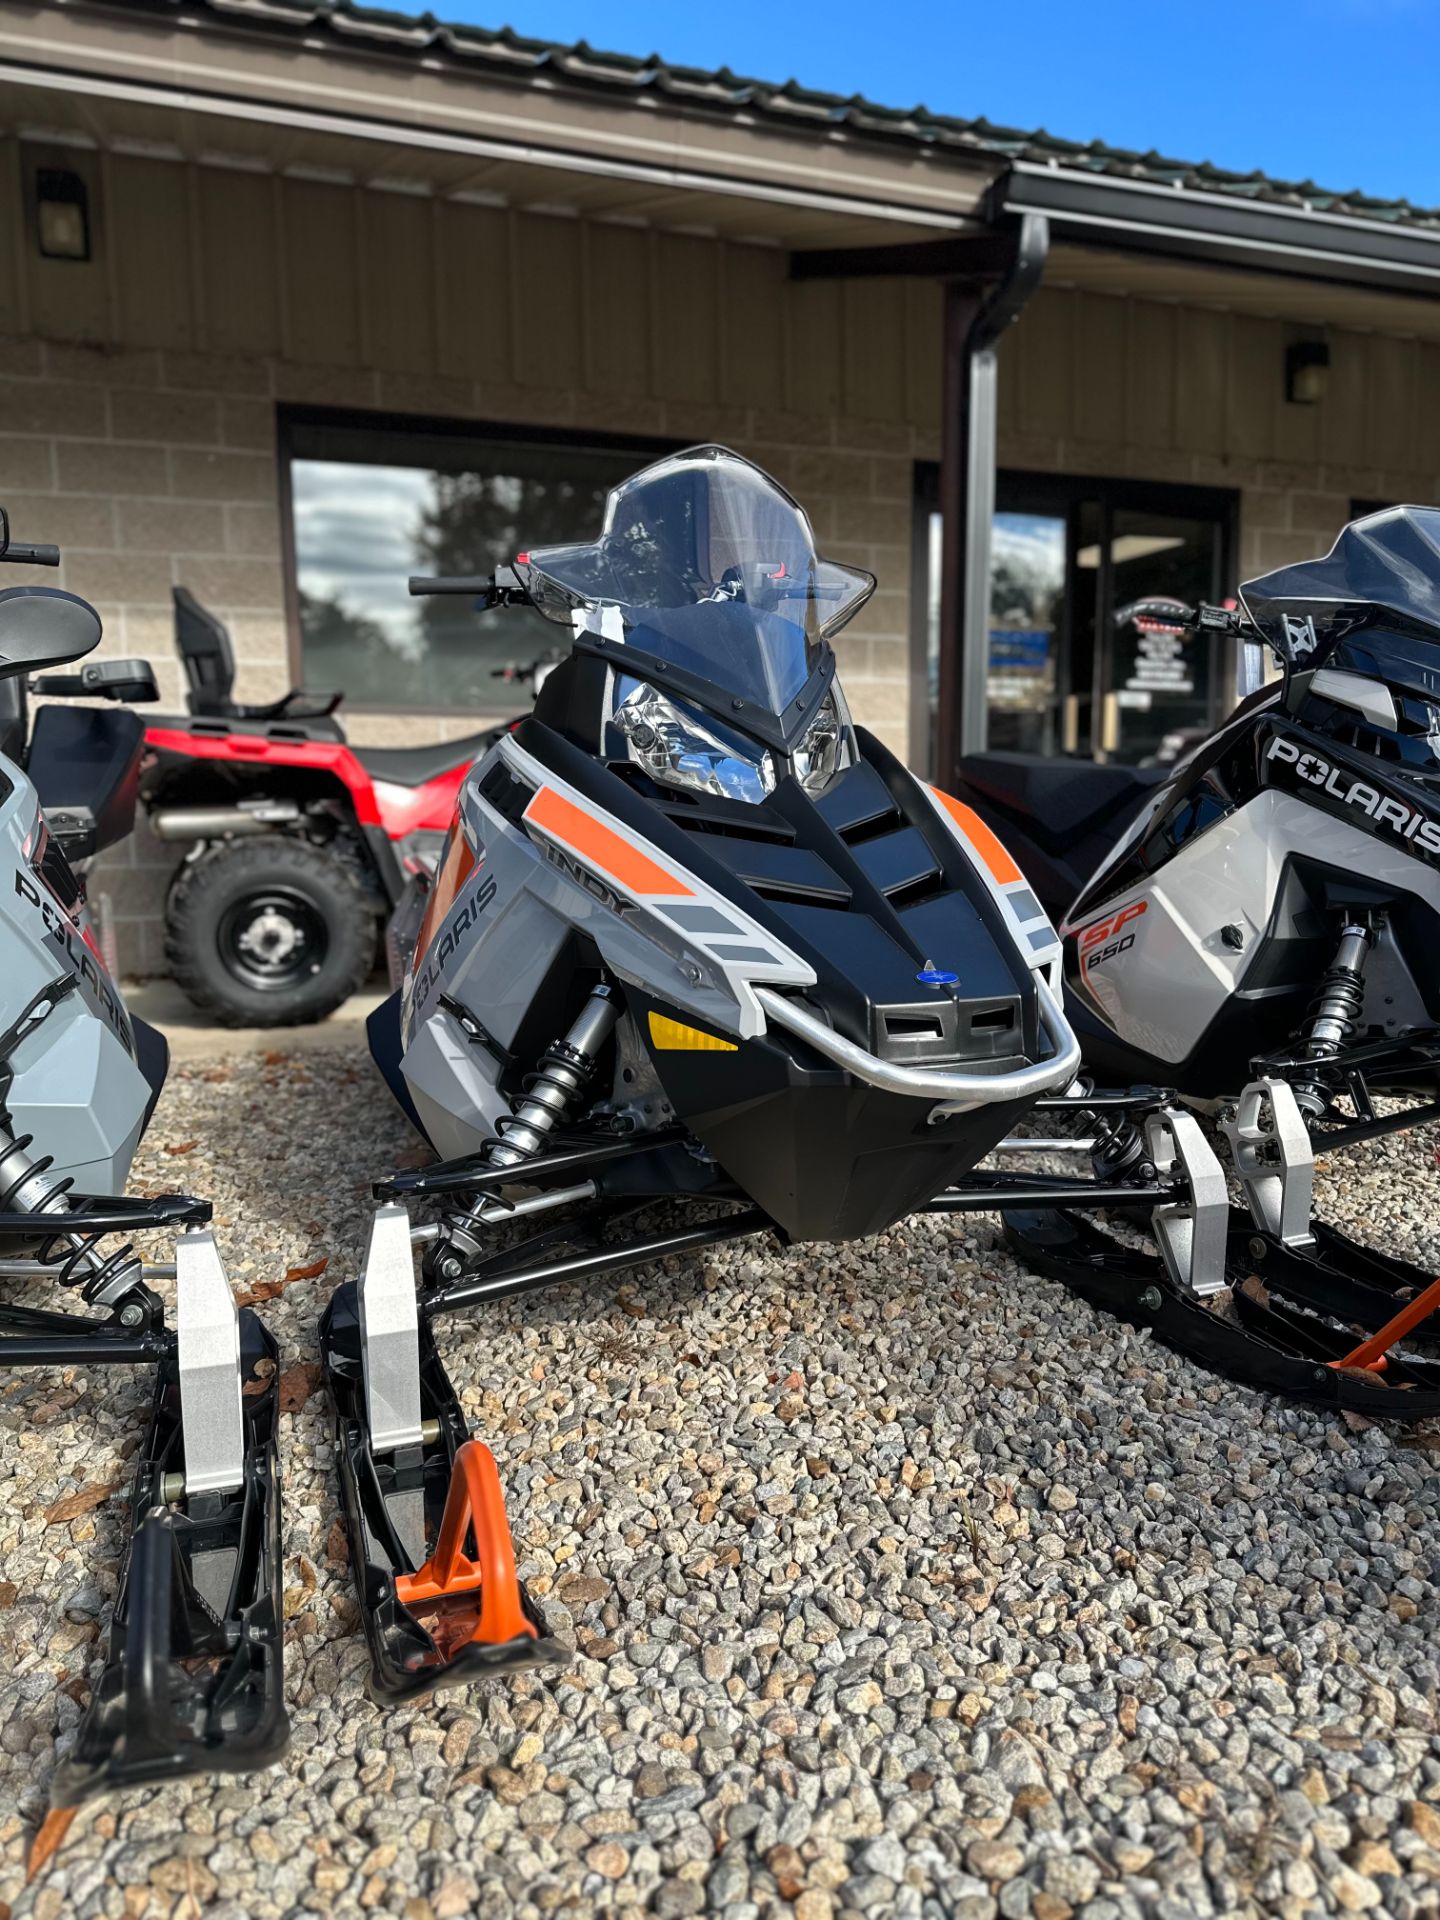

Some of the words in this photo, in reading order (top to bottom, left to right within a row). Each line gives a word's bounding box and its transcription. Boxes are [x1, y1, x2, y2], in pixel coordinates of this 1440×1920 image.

[1266, 737, 1440, 854] POLARIS
[543, 838, 640, 918] INDY
[1082, 900, 1148, 952] SP
[15, 869, 133, 1054] POLARIS
[413, 873, 498, 1014] OLARIS
[1088, 933, 1135, 970] 650
